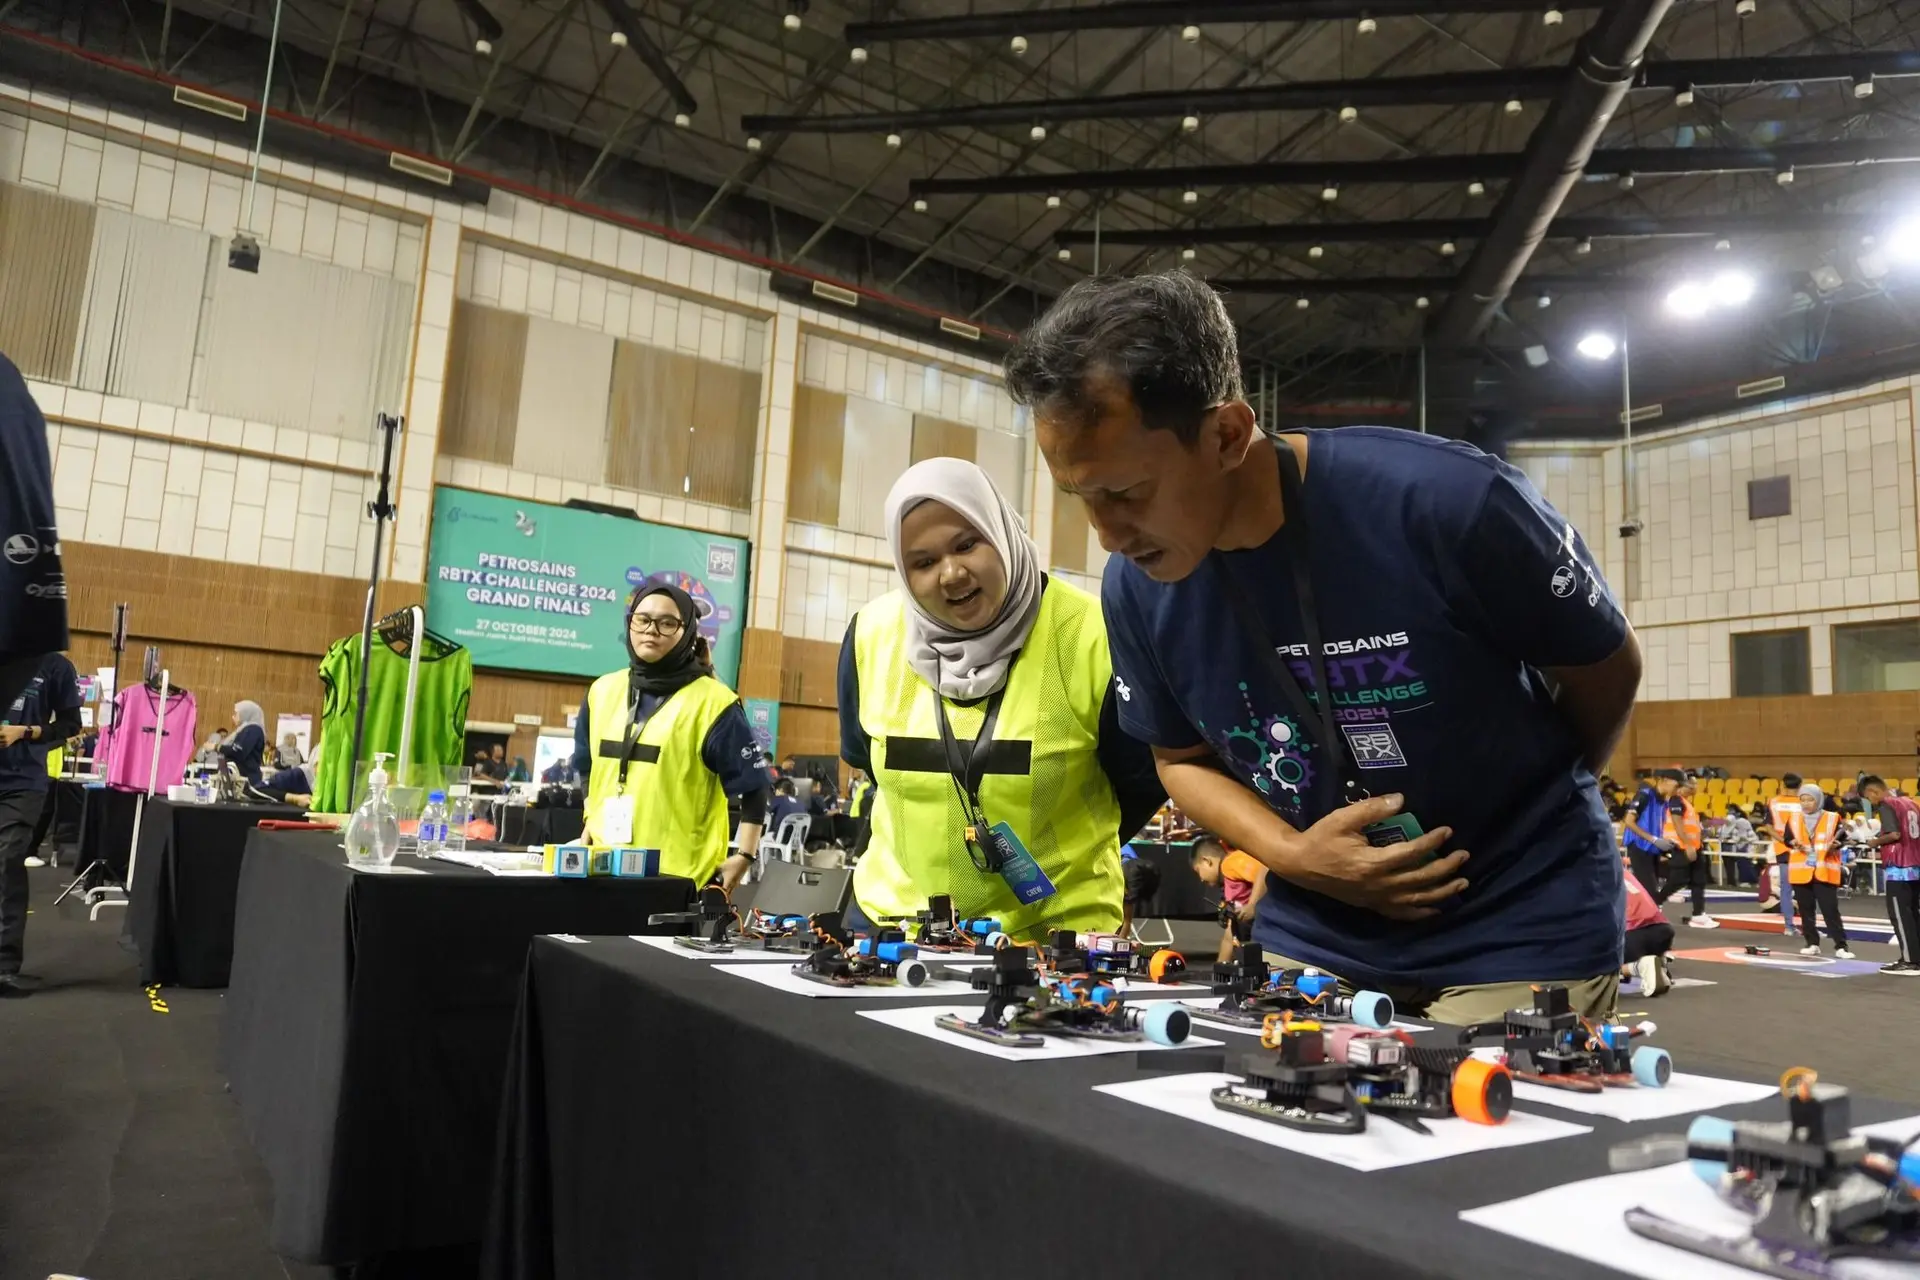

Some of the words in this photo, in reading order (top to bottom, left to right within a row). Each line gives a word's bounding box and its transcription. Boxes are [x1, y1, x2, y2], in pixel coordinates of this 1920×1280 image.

[478, 552, 577, 578] PETROSAINS
[438, 565, 483, 584] RBTX
[485, 573, 577, 597] CHALLENGE
[579, 586, 617, 602] 2024
[466, 587, 530, 608] GRAND
[533, 595, 591, 616] FINALS
[475, 618, 491, 630] 27
[491, 621, 547, 637] OCTOBER
[548, 628, 577, 640] 2024
[1275, 631, 1410, 657] PETOSAINS
[1025, 885, 1043, 897] CREW
